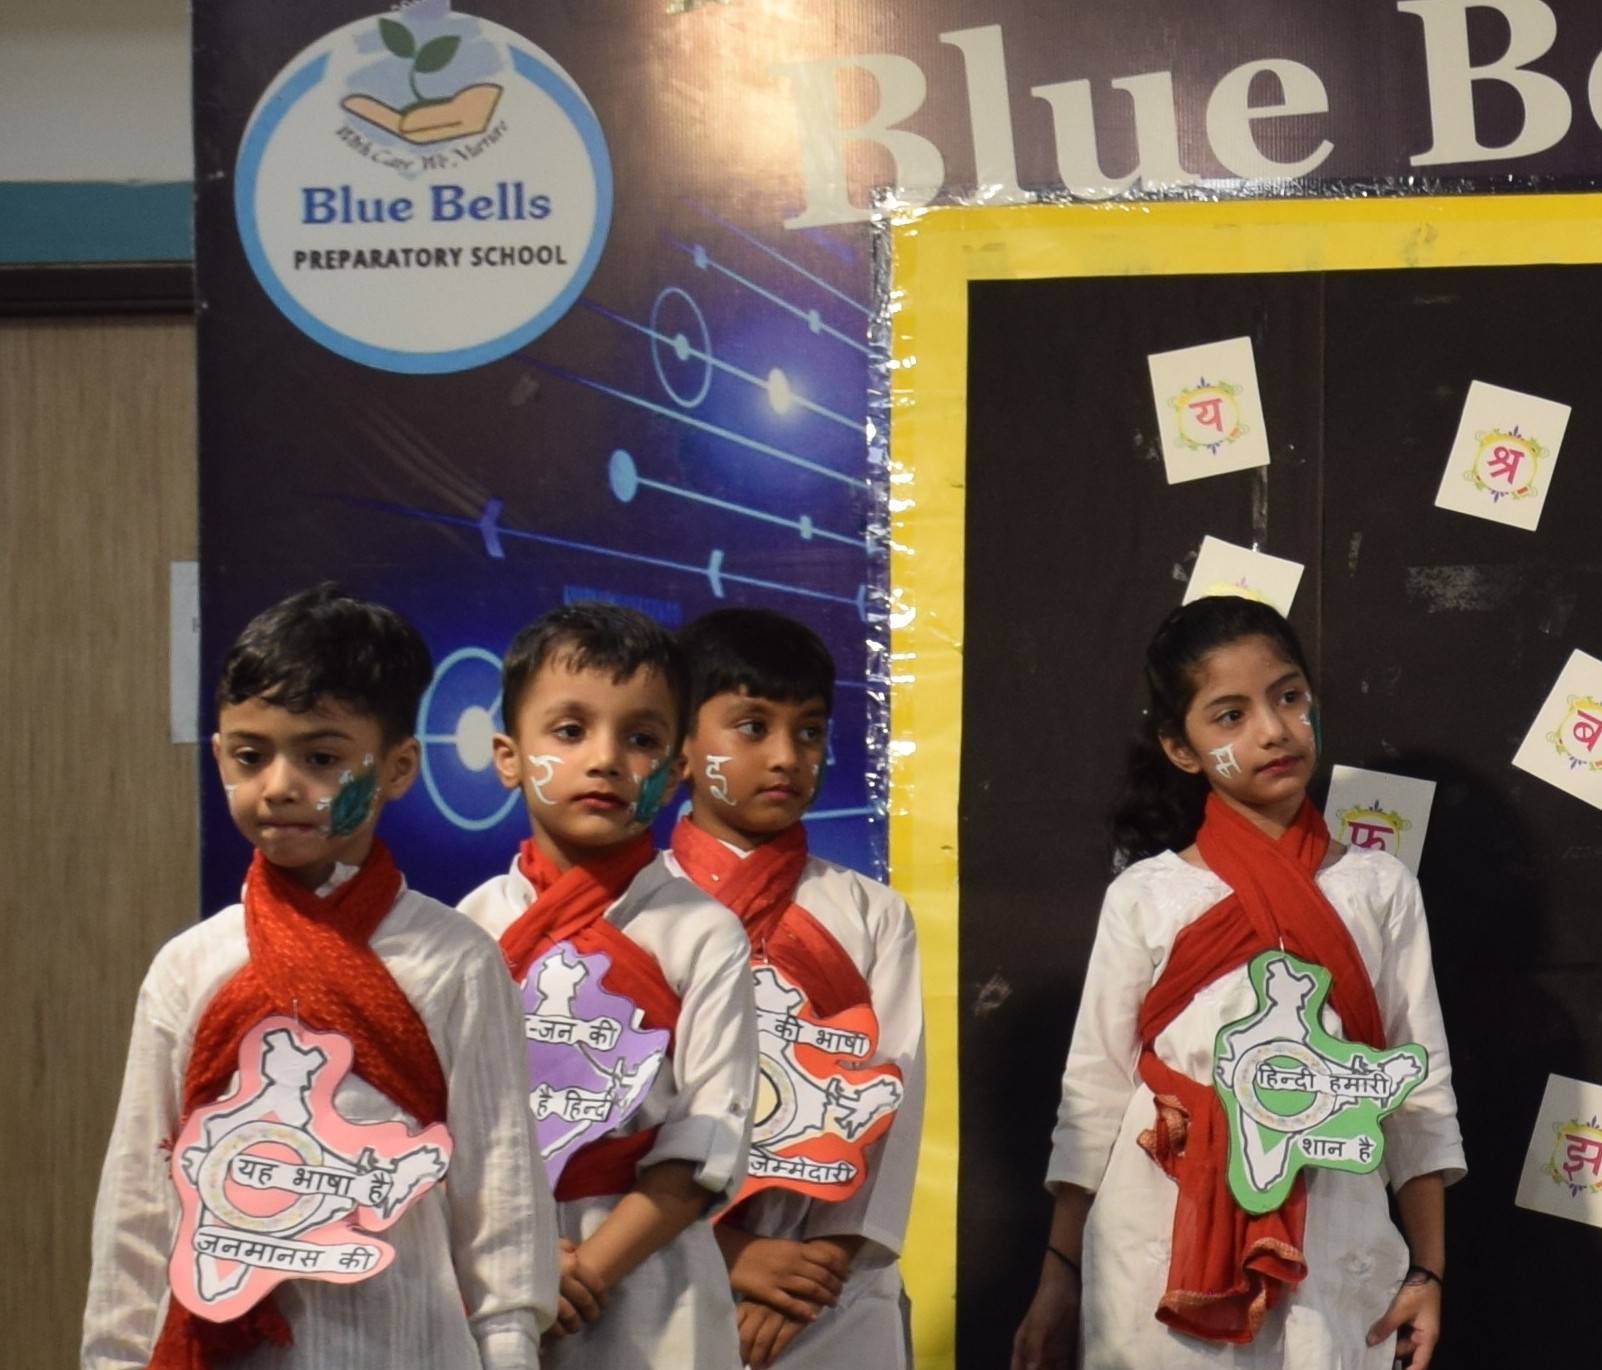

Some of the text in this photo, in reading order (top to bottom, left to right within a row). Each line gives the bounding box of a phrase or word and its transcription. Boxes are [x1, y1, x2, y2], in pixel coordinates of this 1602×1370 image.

[768, 24, 1334, 230] Blue
[302, 180, 552, 224] Blue Bells
[294, 245, 567, 271] PREPARATORY SCHOOL
[1188, 397, 1224, 433] य
[524, 1017, 618, 1047] -जन की
[775, 1014, 867, 1055] की भाषा
[1258, 1065, 1391, 1097] हिन्दी हमारी
[537, 1087, 553, 1117] है
[1302, 1136, 1375, 1163] शान है
[237, 1156, 393, 1208] यह भाषा है
[197, 1232, 375, 1271] जनमानस की
